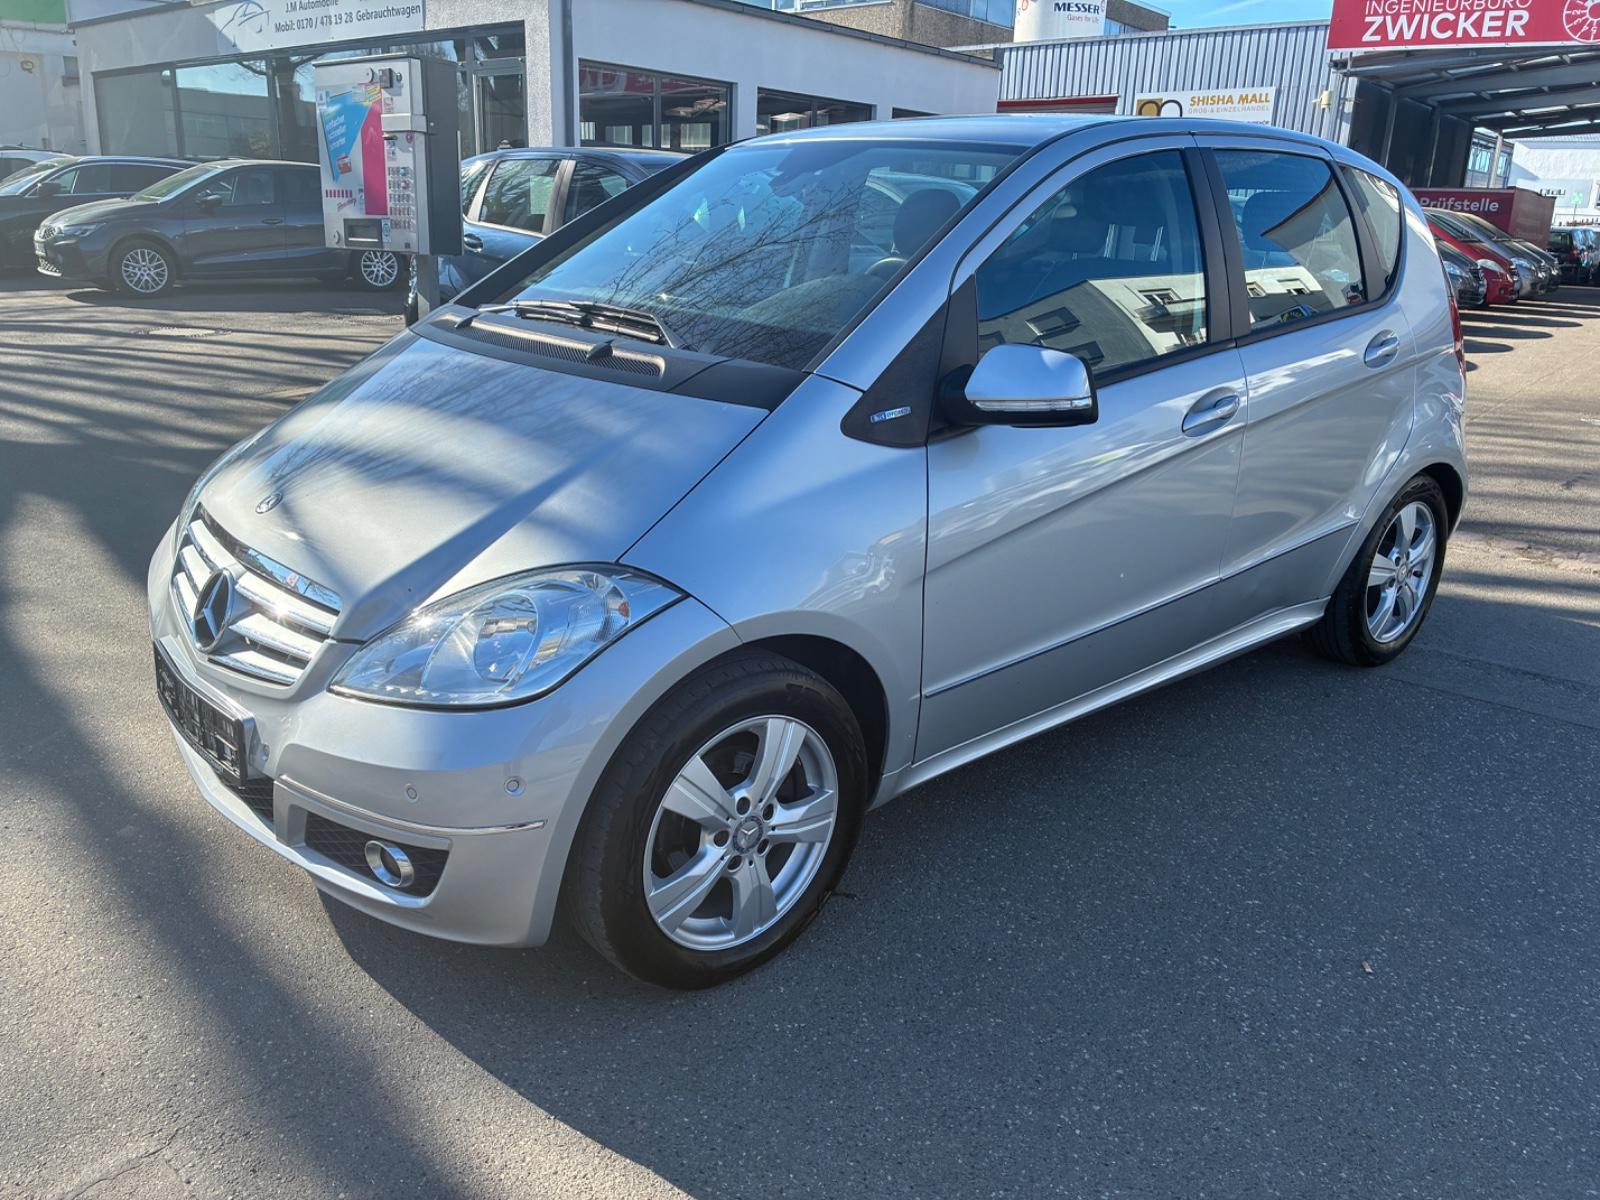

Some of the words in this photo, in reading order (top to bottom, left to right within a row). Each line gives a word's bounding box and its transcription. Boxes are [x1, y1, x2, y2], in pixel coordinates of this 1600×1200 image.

[1054, 2, 1100, 15] MESSER
[274, 21, 295, 32] Mobil:
[296, 18, 313, 30] 0170
[319, 15, 333, 26] 478
[334, 13, 343, 25] 19
[344, 11, 354, 23] 28
[356, 4, 421, 21] Gebrauchtwagen
[1361, 10, 1530, 42] ZWICKER
[1190, 95, 1234, 106] SHISHA
[1238, 93, 1270, 105] MALL
[1419, 197, 1500, 211] Prüfstelle
